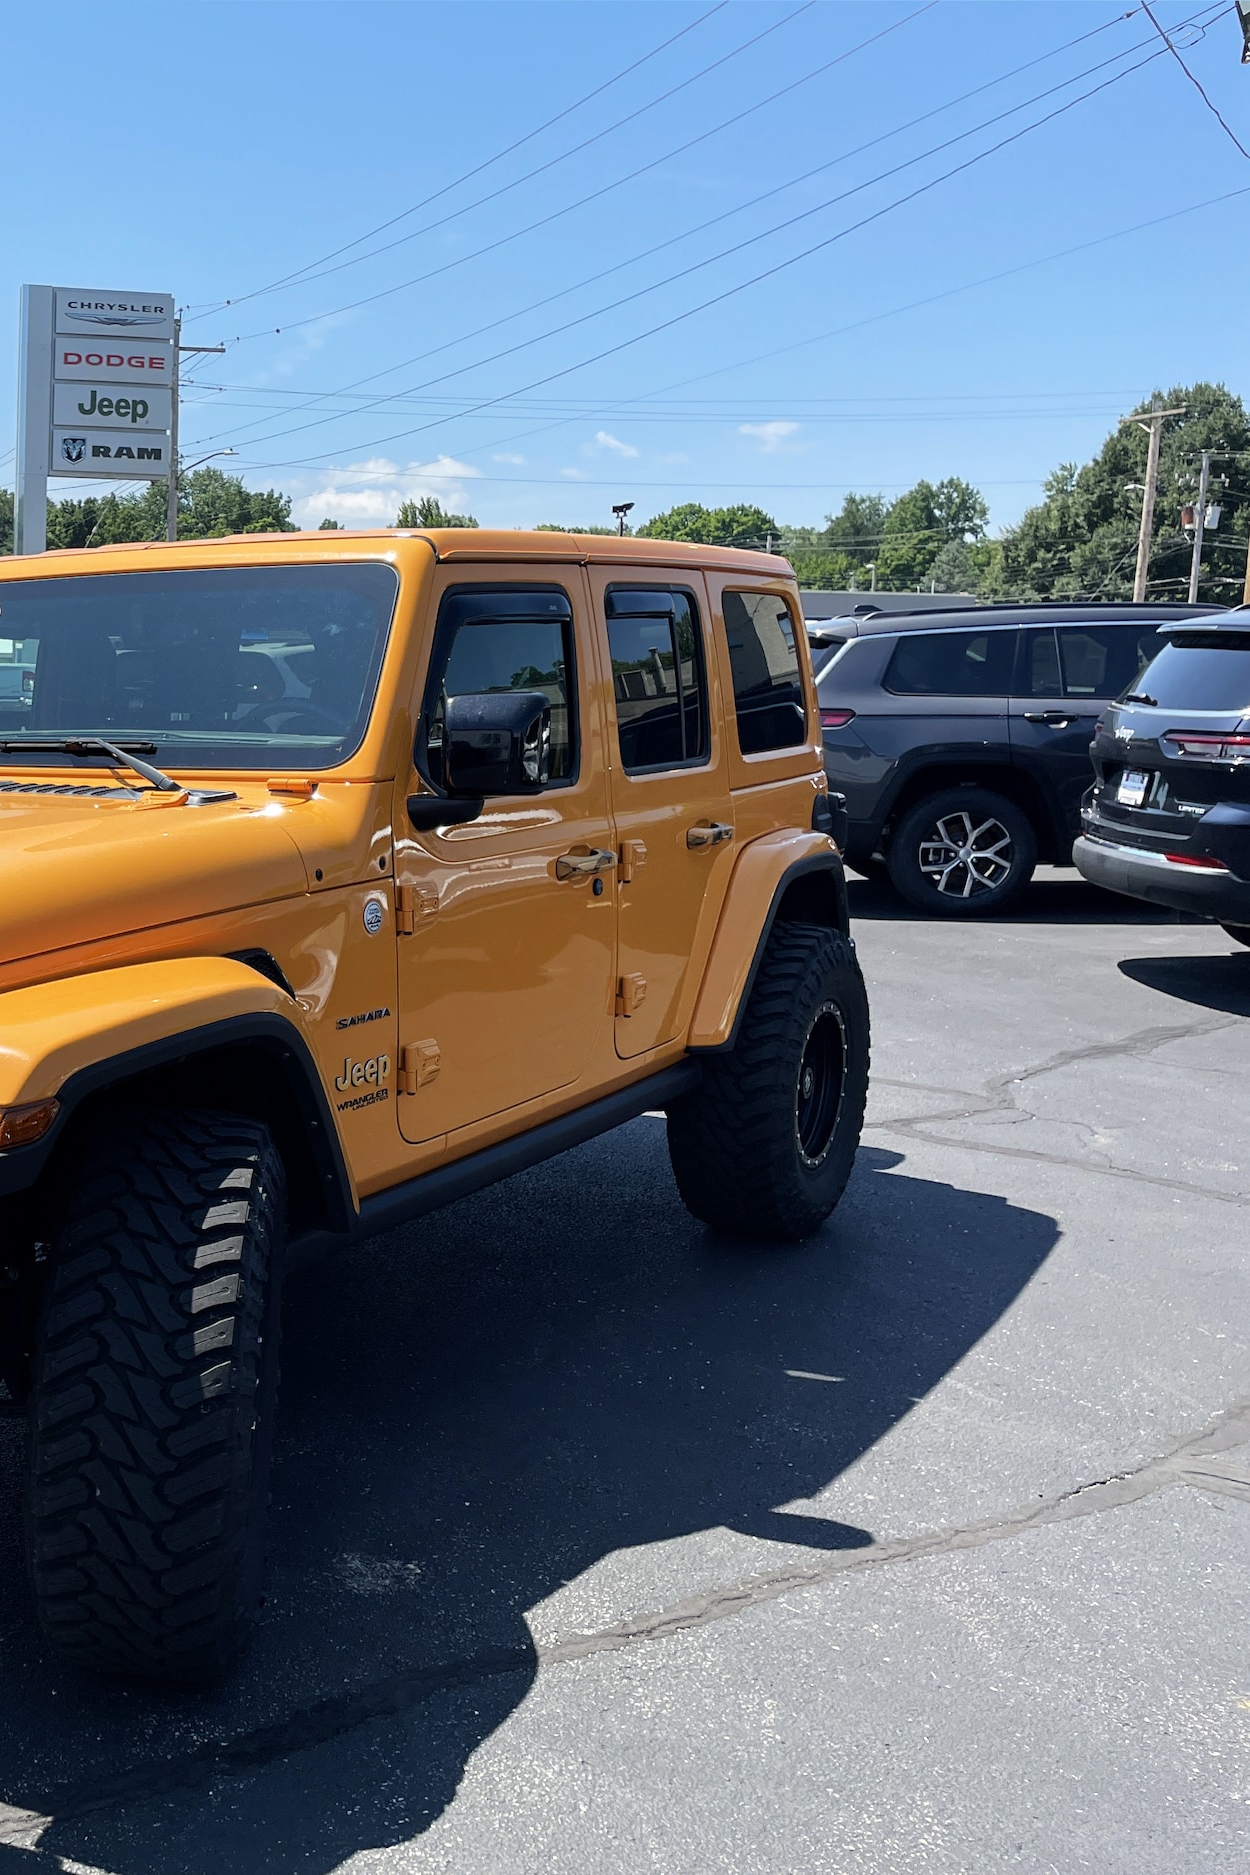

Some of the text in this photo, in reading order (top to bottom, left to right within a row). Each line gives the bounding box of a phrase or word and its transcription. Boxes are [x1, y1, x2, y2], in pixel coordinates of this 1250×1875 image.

[67, 301, 164, 314] CHRYSLER
[63, 352, 165, 370] DODGE
[77, 390, 149, 423] Jeep
[91, 445, 162, 461] RAM
[336, 1007, 390, 1030] SAHARA
[335, 1054, 390, 1091] Jeep
[337, 1088, 388, 1112] WRANGLER
[352, 1095, 389, 1111] UNLIMITED
